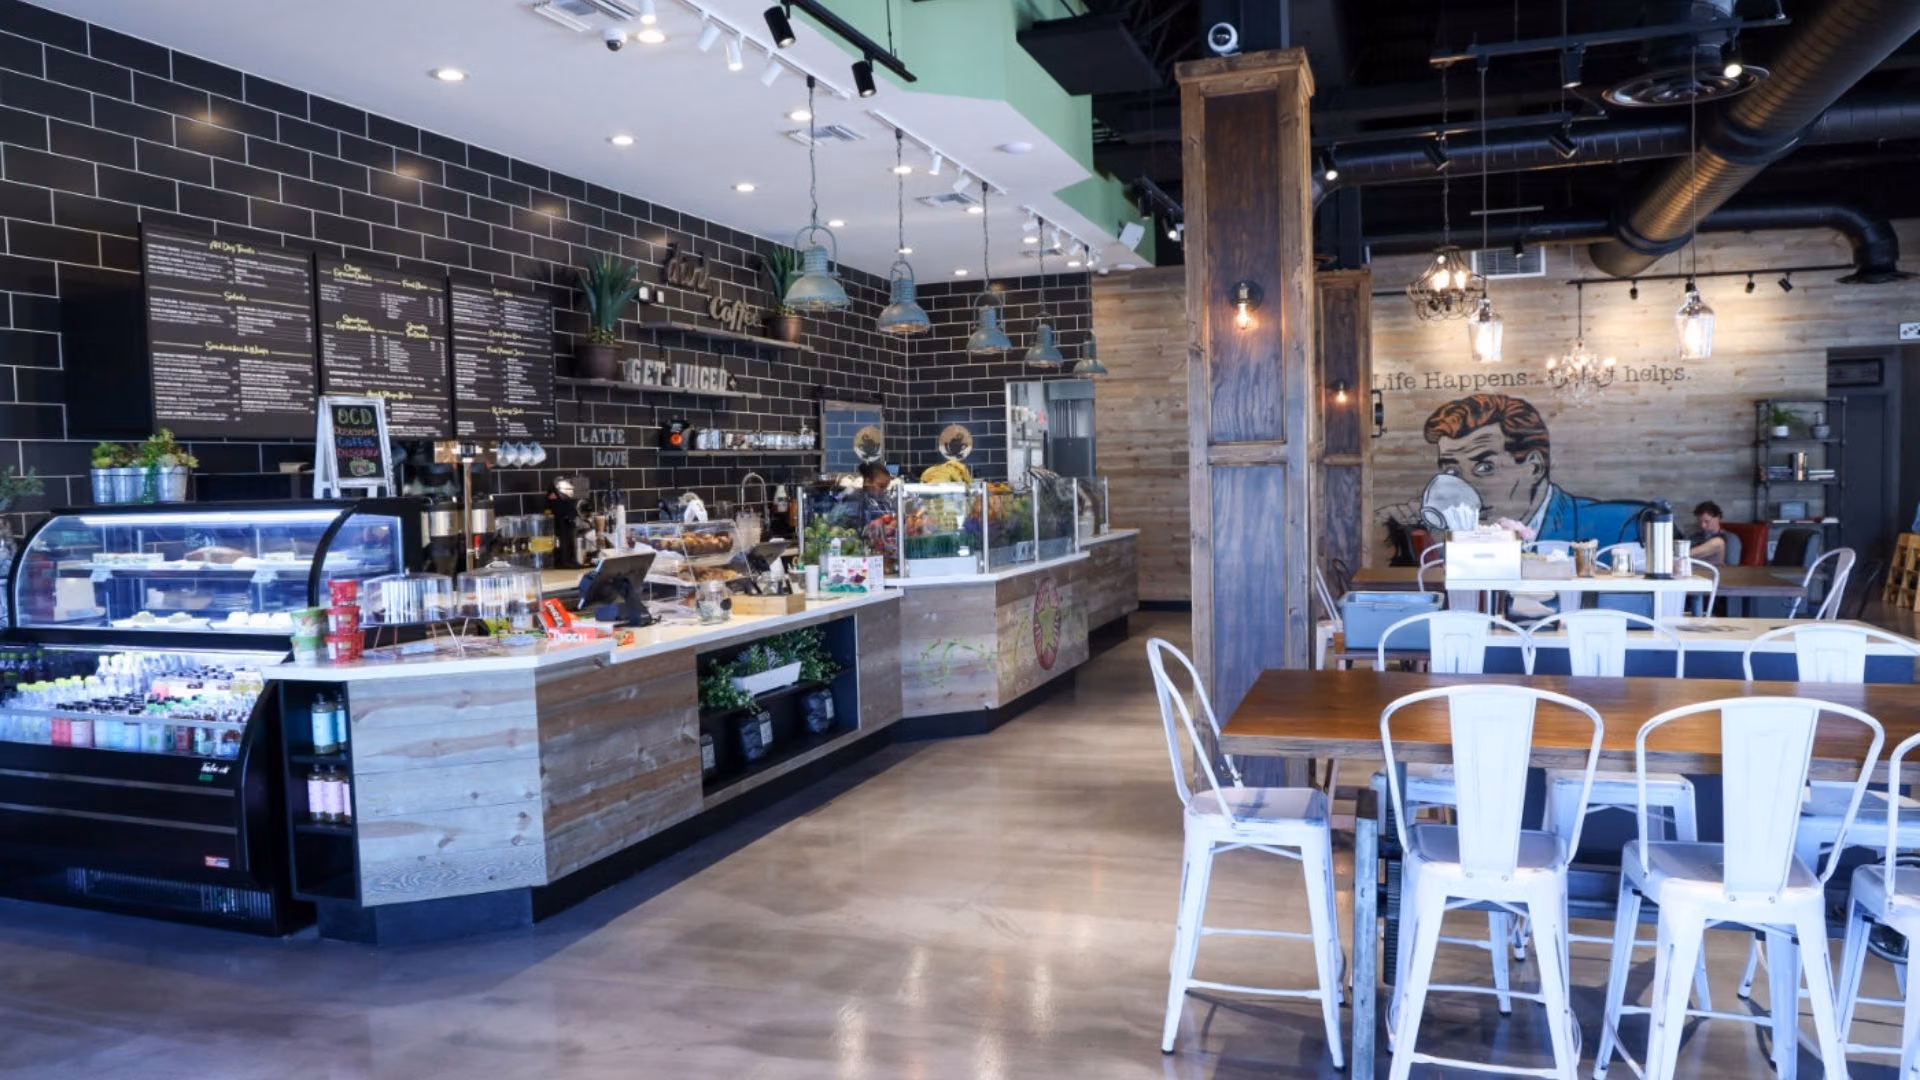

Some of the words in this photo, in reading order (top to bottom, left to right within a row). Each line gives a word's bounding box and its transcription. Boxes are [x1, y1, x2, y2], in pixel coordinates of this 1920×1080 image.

[630, 358, 666, 386] GET
[671, 363, 728, 392] JUICED
[1374, 371, 1416, 391] Life
[337, 408, 373, 424] OCD
[581, 427, 625, 444] LATTE
[597, 450, 629, 466] LOVE
